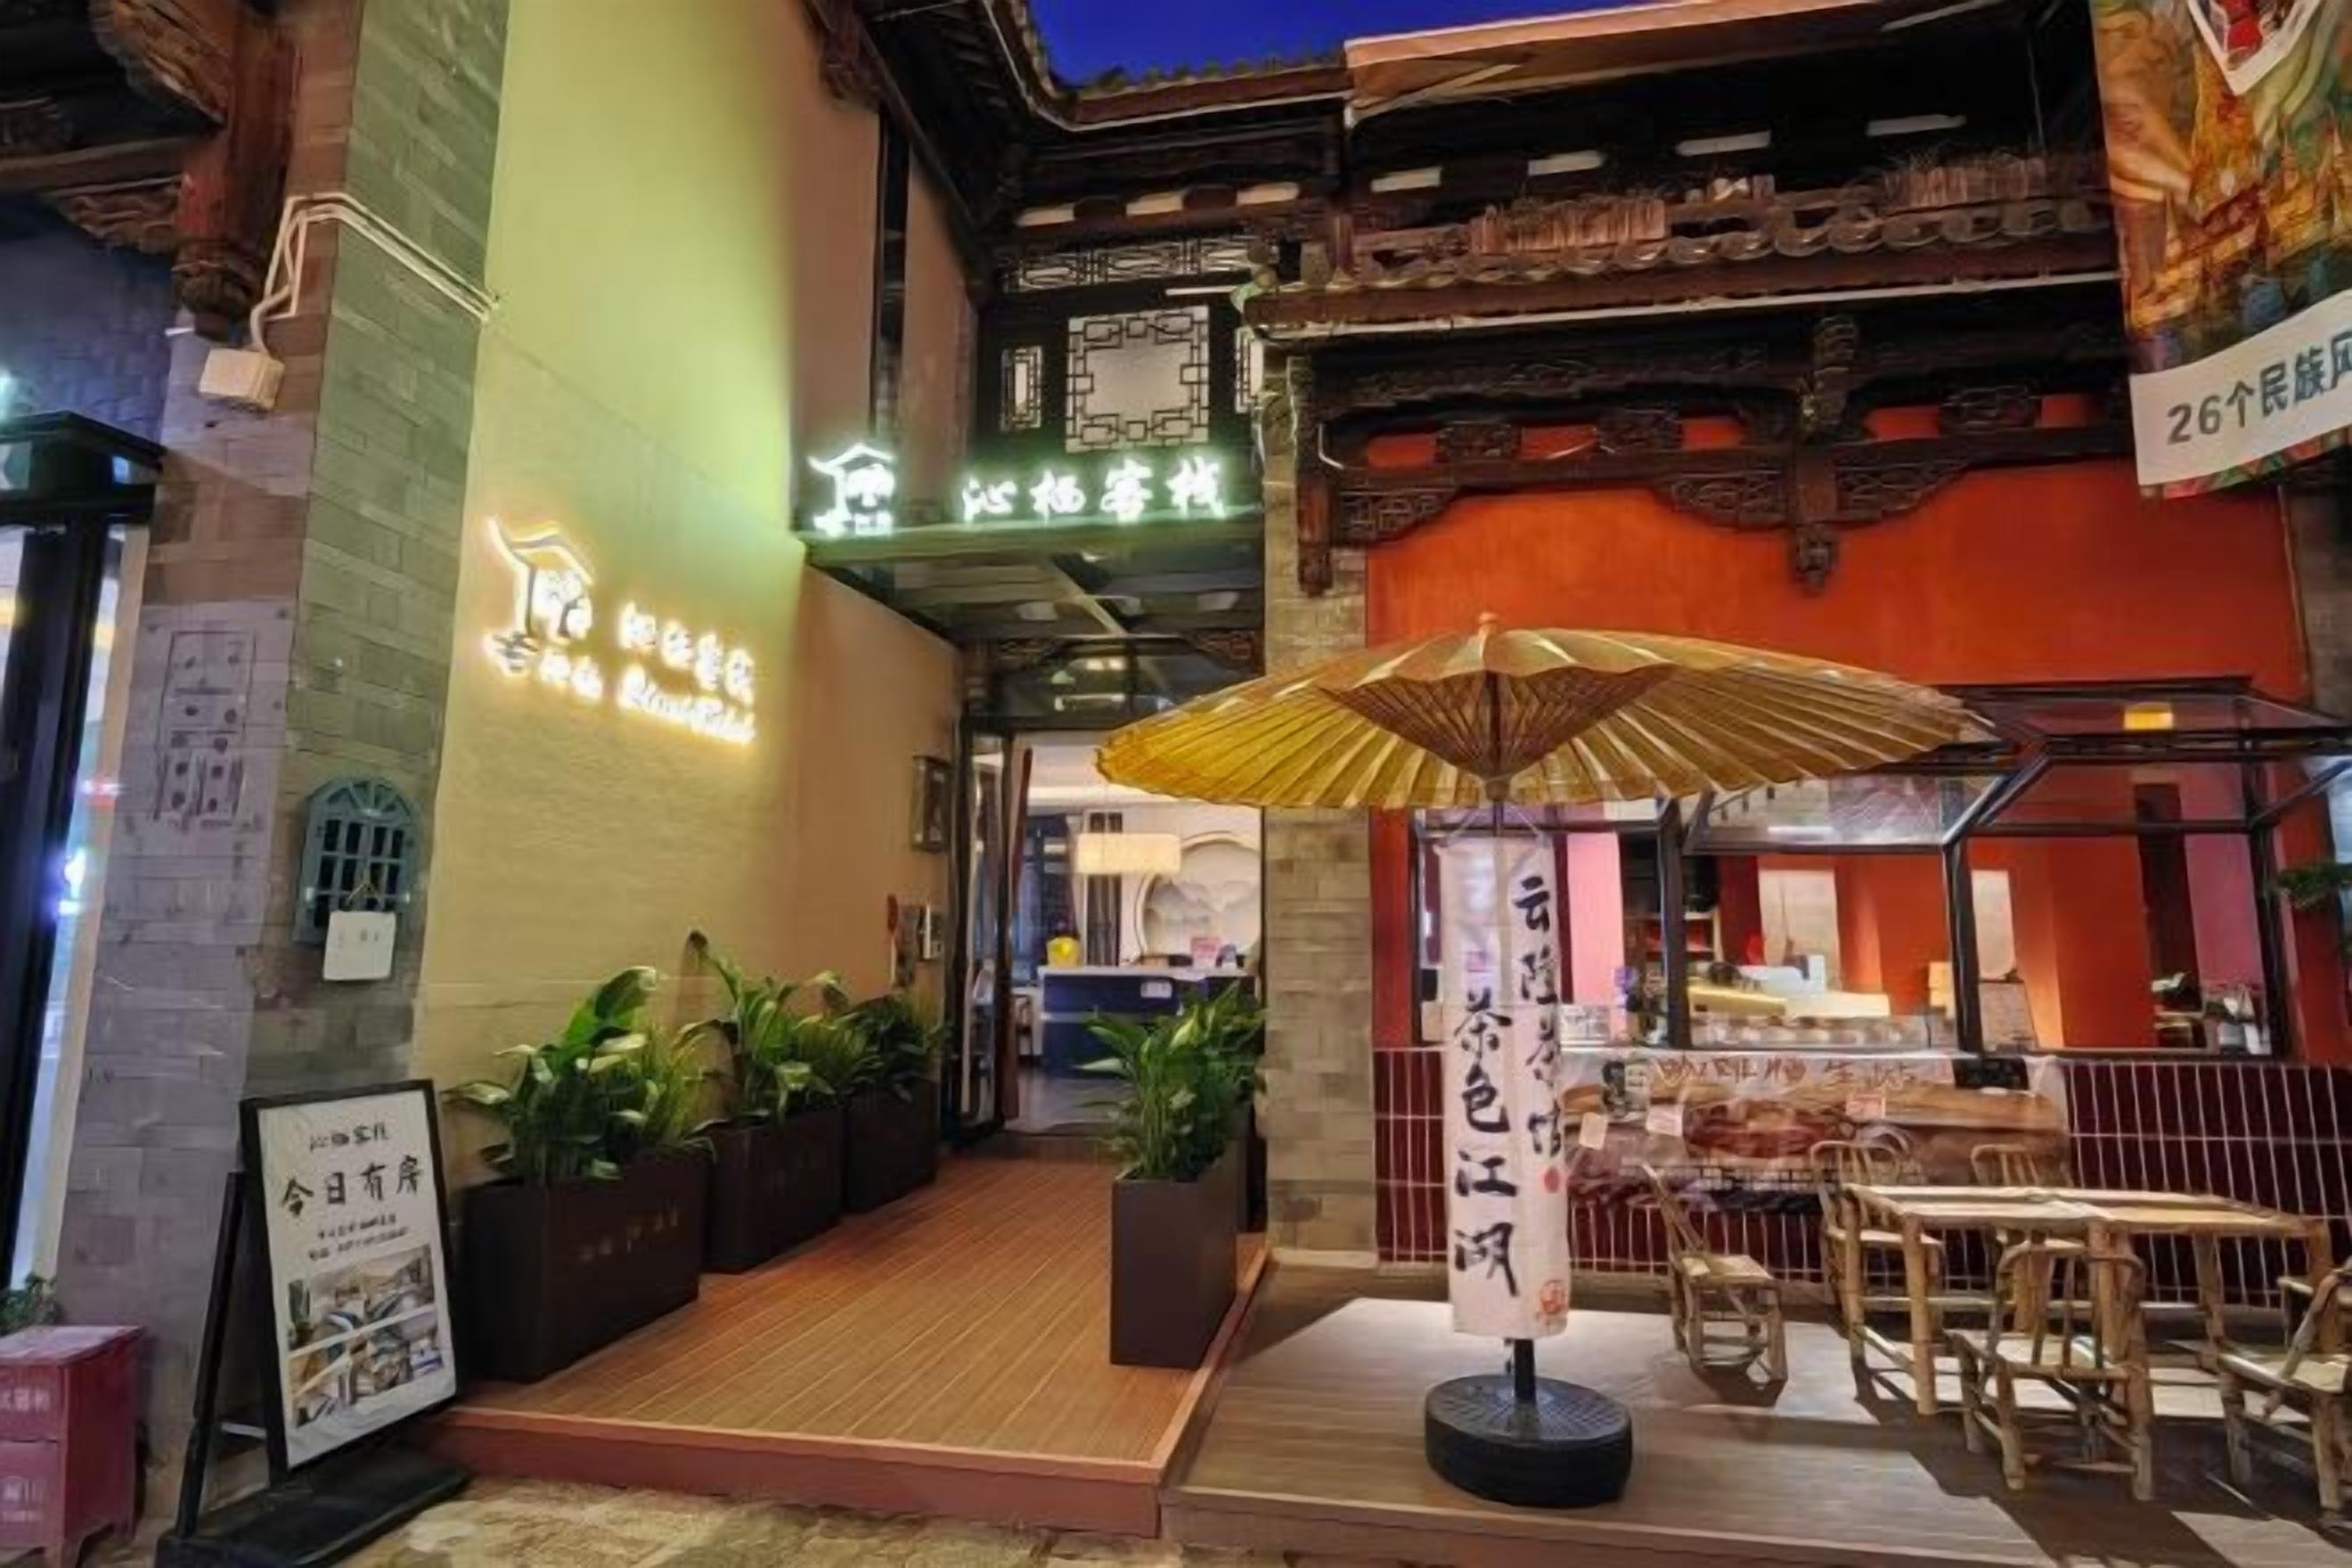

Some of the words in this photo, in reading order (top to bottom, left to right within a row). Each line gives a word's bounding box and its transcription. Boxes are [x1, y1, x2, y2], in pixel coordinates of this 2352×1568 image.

[282, 1154, 422, 1217] 今日有房
[1454, 987, 1519, 1297] 茶色江湖
